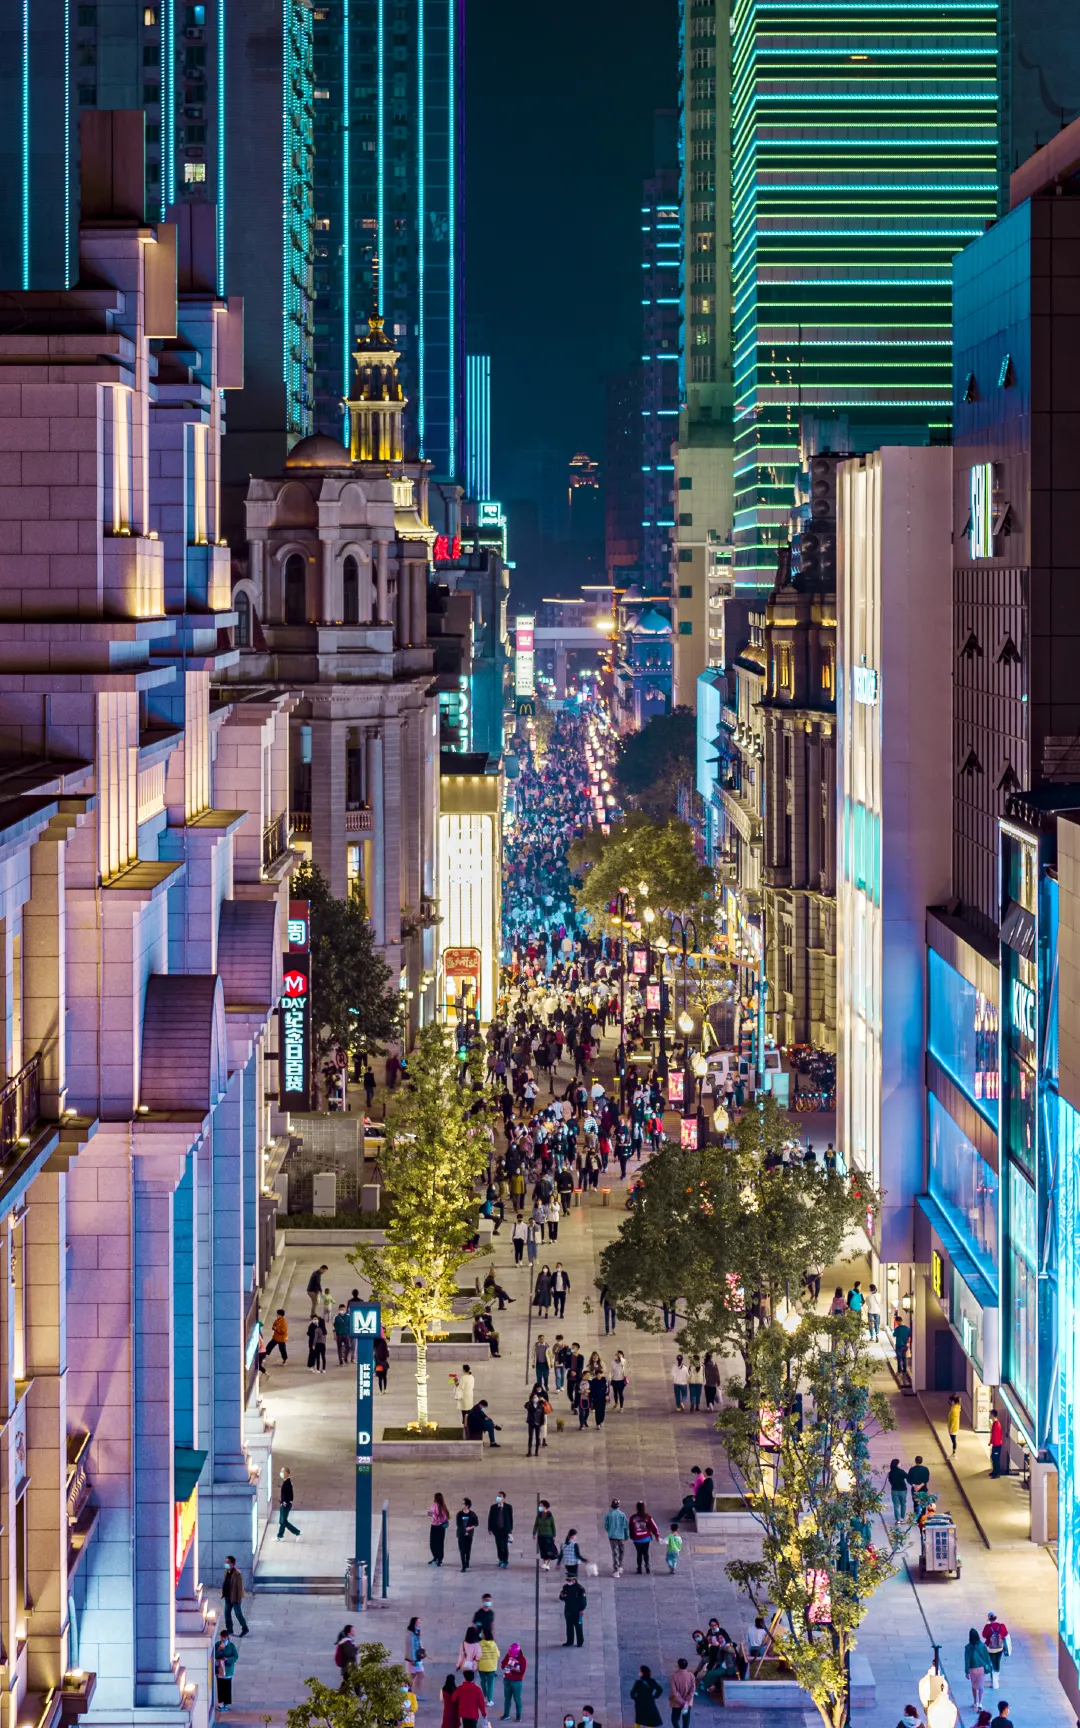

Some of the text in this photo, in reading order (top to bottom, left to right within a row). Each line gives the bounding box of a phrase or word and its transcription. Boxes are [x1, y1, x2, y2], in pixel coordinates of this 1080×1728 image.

[284, 975, 303, 992] M
[281, 997, 307, 1009] DAY
[358, 1431, 371, 1445] D
